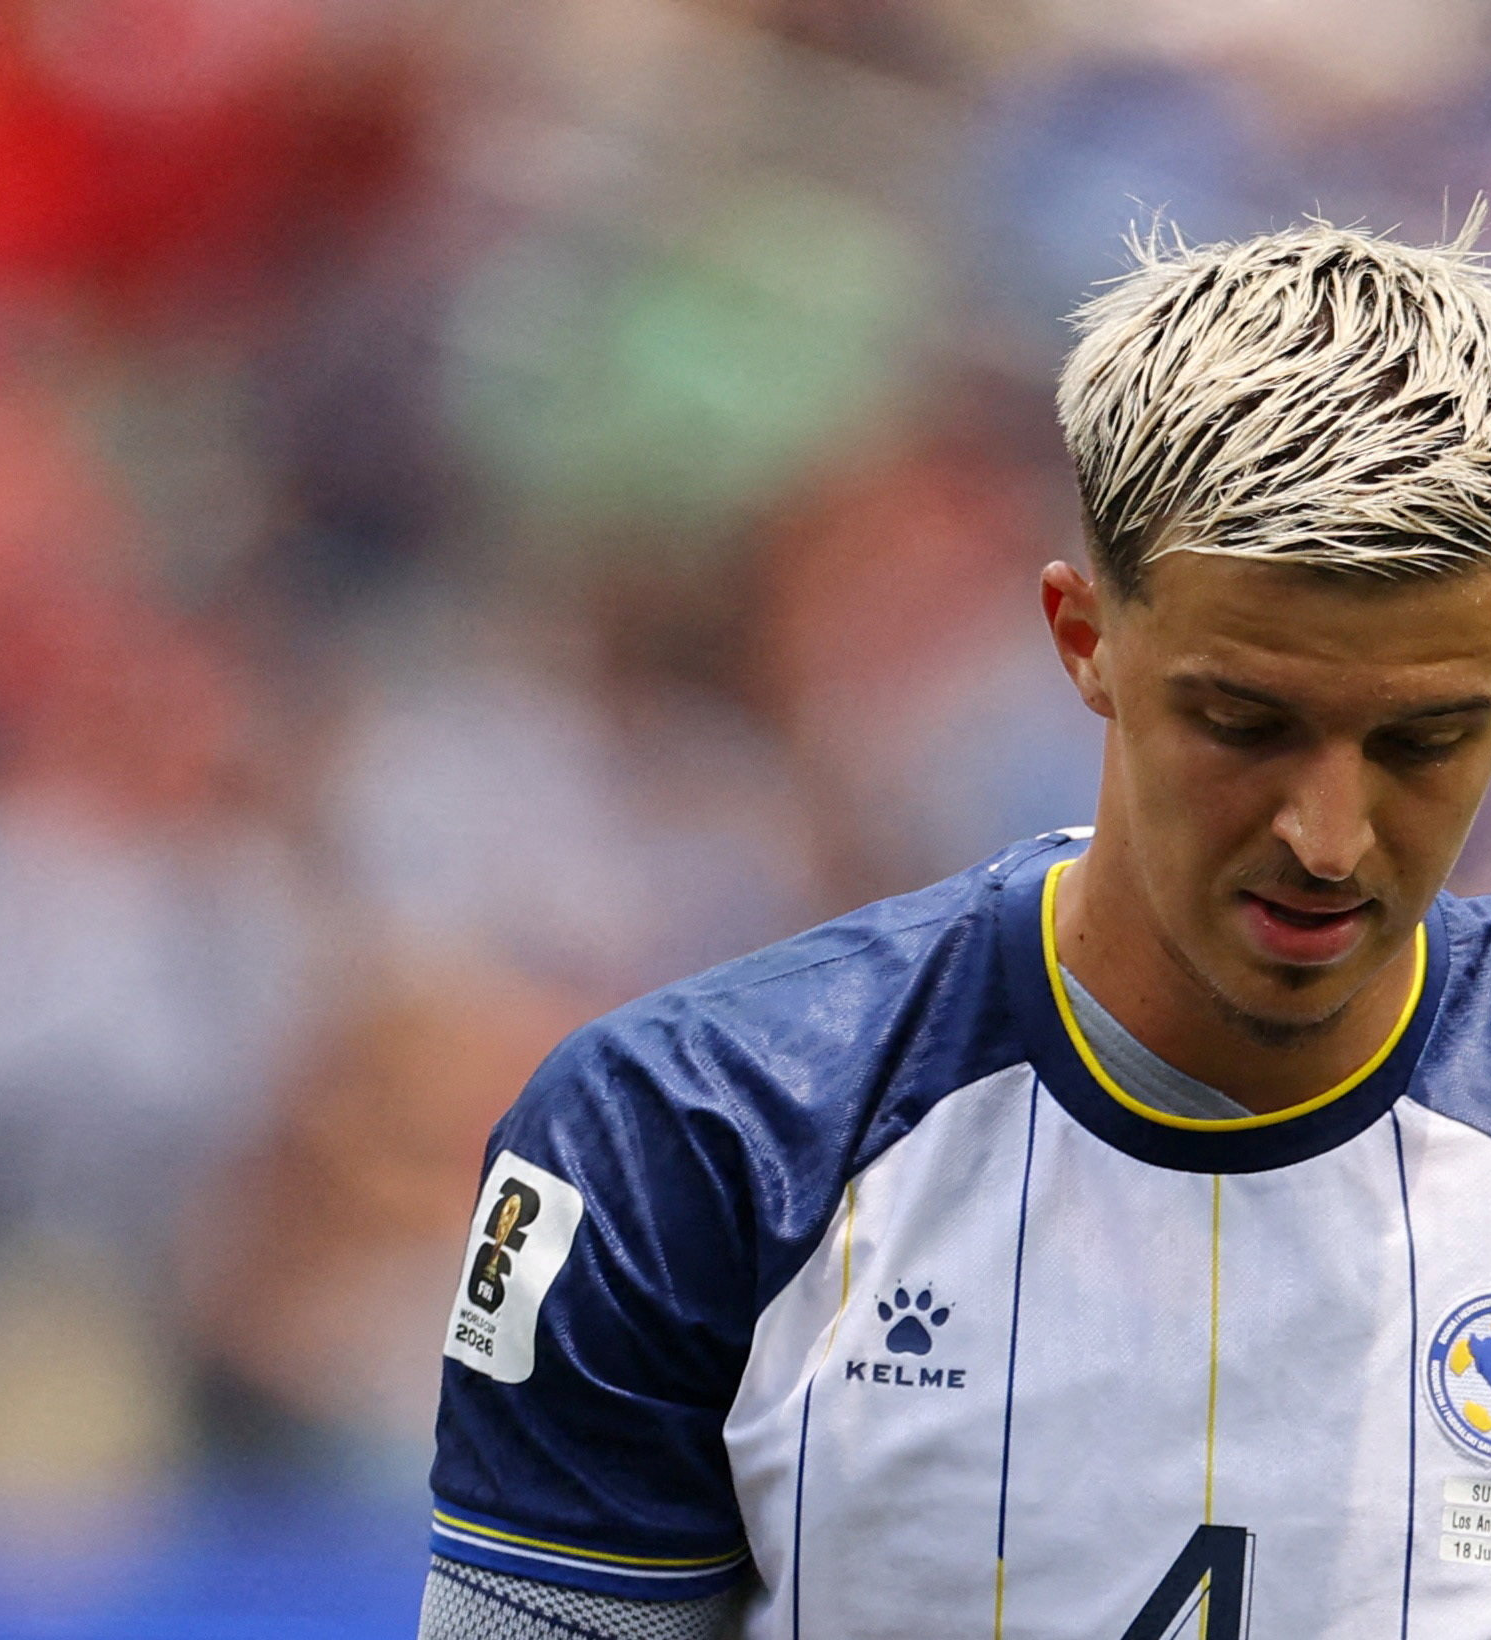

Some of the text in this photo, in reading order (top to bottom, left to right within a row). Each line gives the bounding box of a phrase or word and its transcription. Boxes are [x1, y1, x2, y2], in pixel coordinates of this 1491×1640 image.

[455, 1323, 494, 1357] 2026
[845, 1361, 967, 1389] KELME
[1452, 1511, 1471, 1530] Los
[1454, 1541, 1471, 1559] 18
